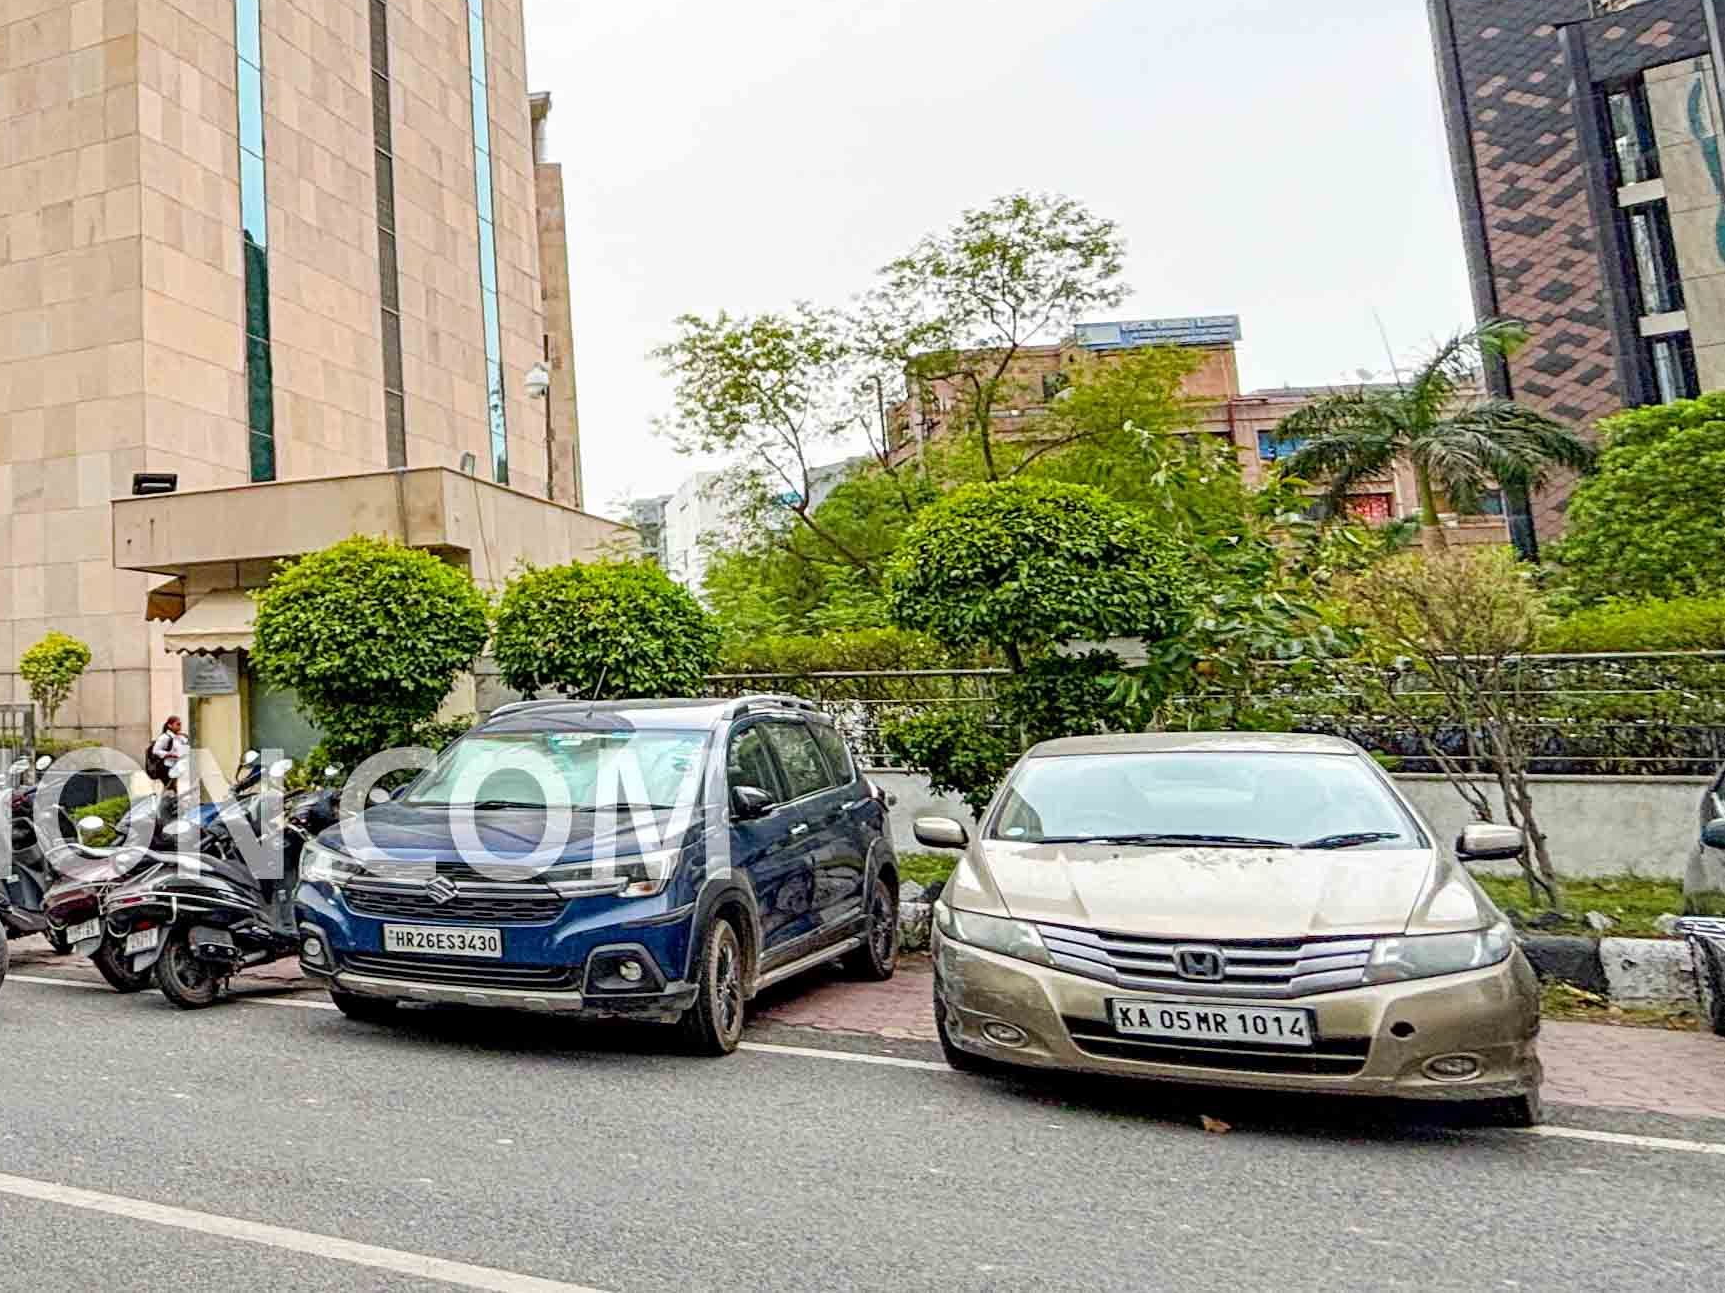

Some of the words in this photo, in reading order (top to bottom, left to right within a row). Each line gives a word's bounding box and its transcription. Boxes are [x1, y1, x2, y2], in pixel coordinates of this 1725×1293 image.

[395, 930, 498, 952] HR26ES3430
[1118, 1006, 1152, 1029] KA
[1237, 1013, 1306, 1038] 1014
